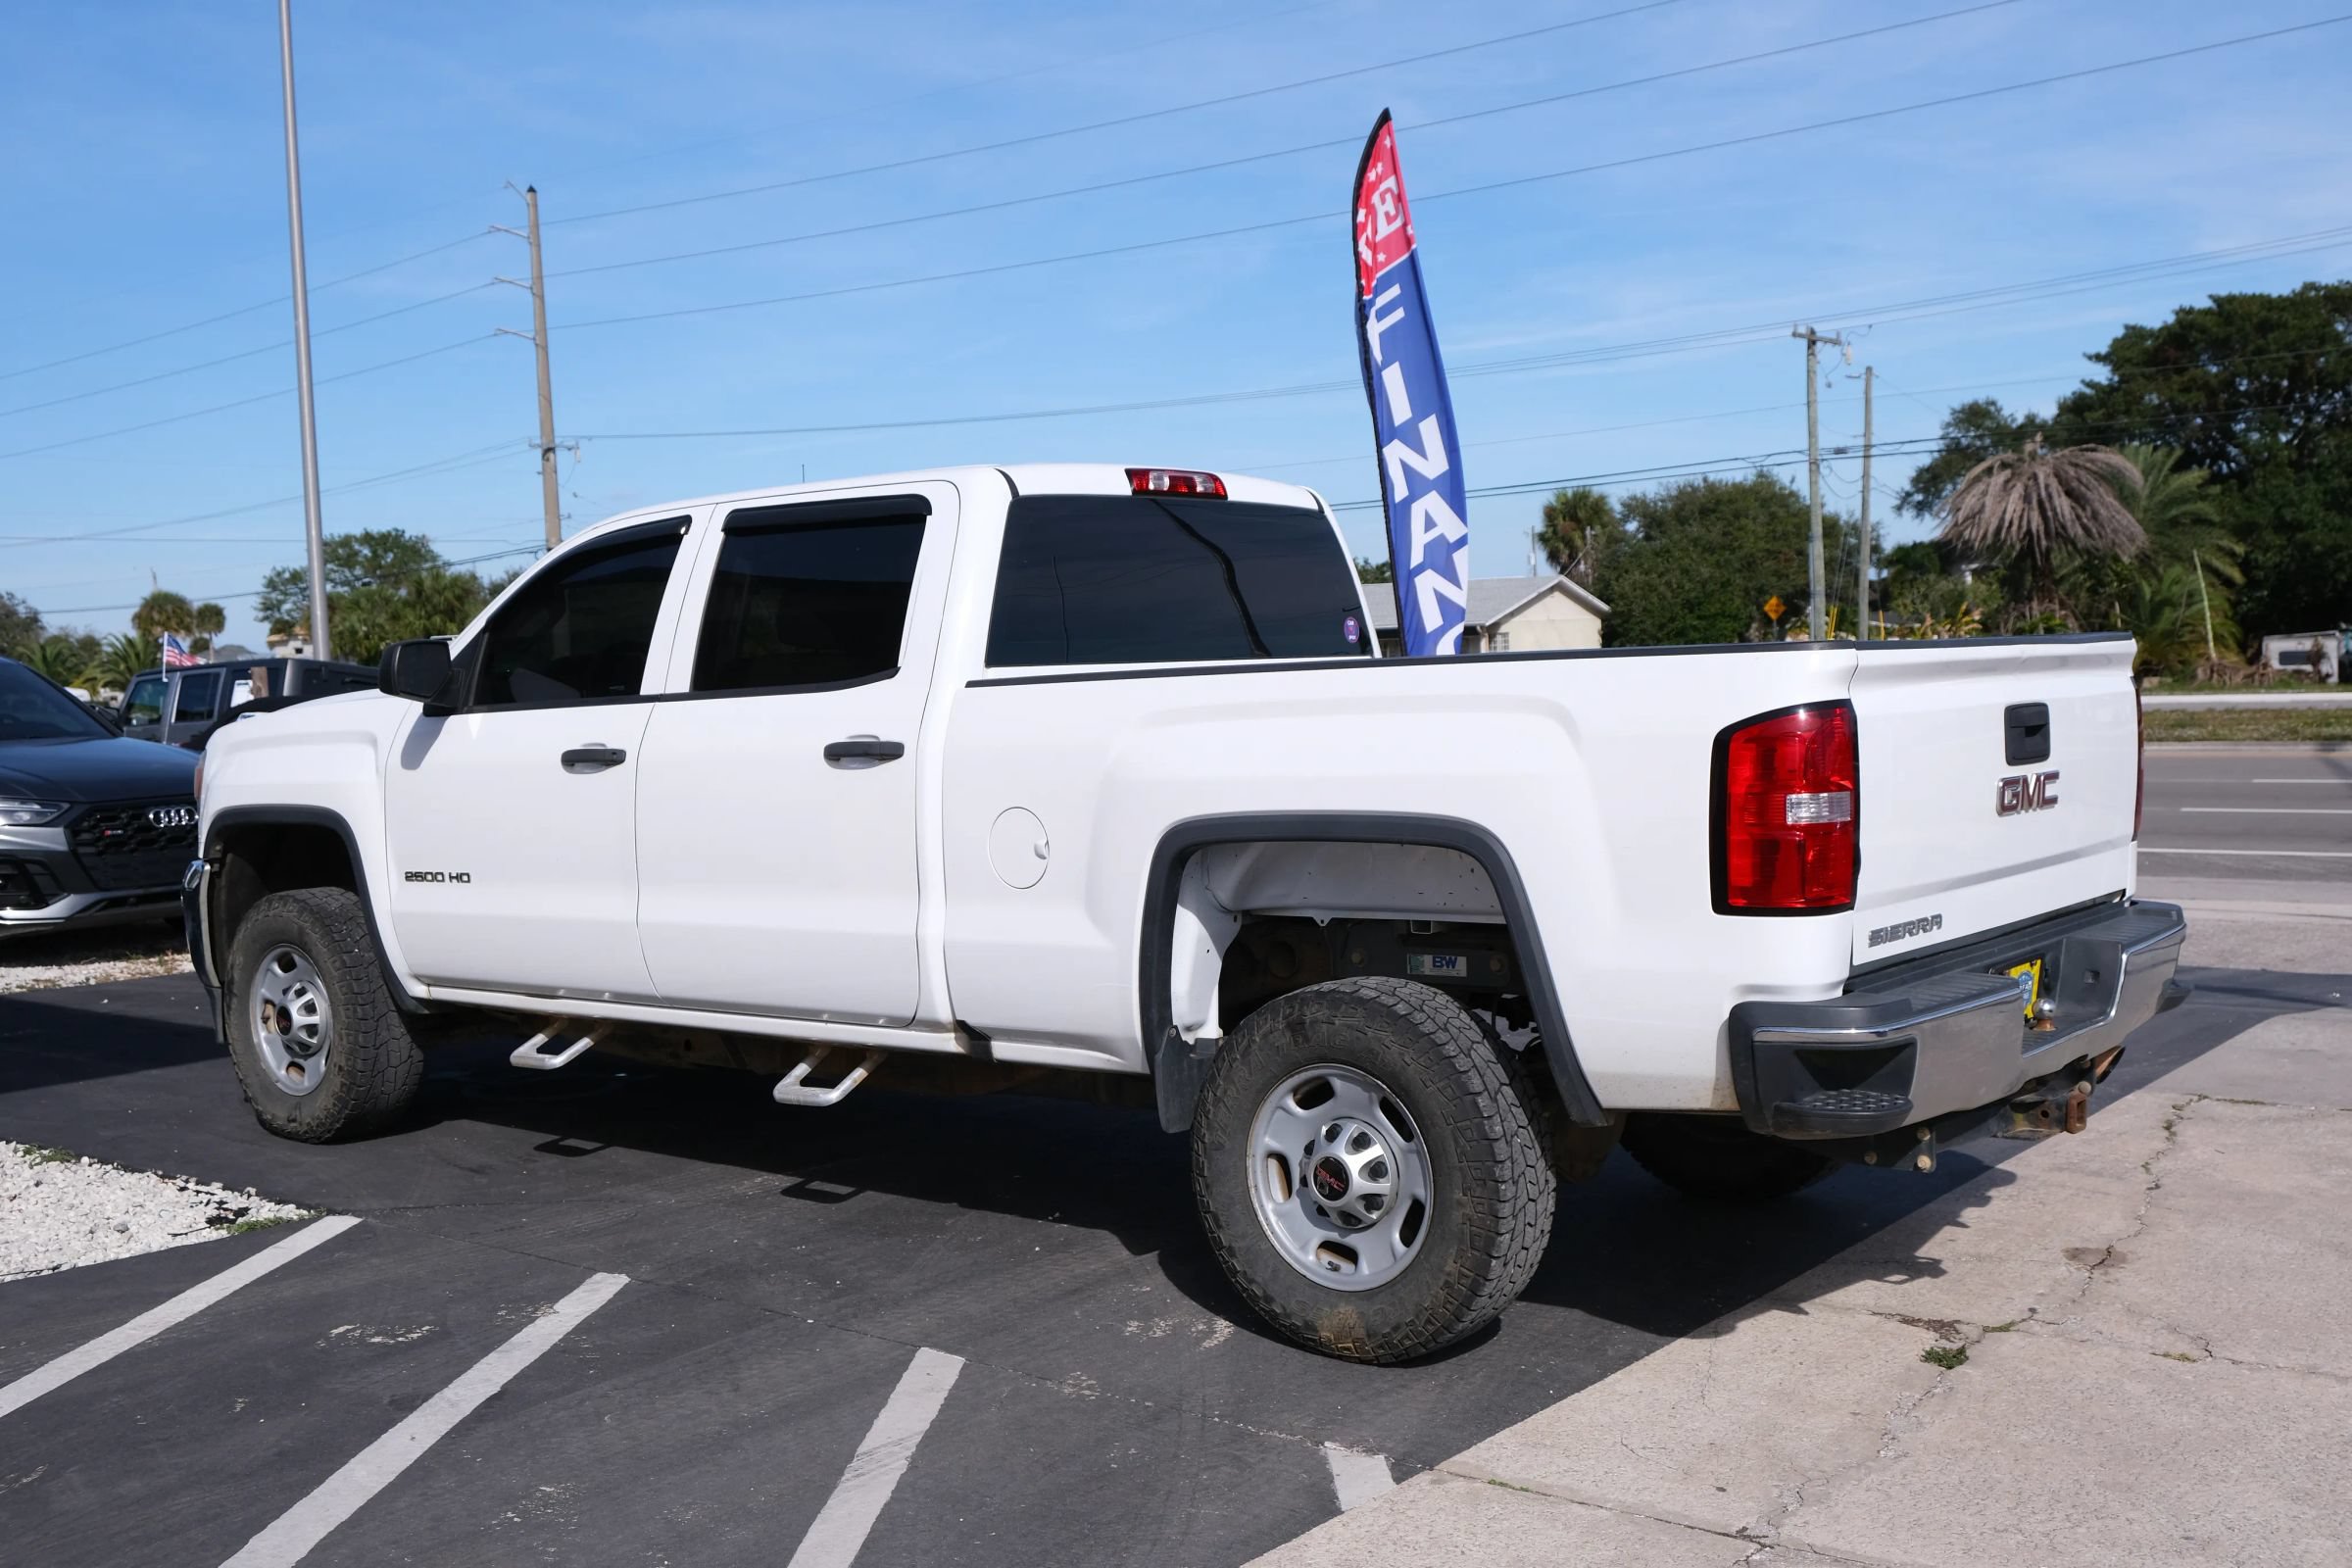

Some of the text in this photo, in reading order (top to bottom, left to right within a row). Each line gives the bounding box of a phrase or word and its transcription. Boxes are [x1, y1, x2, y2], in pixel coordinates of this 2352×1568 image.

[1996, 770, 2060, 817] GMC
[404, 871, 445, 883] 2500
[1868, 913, 1943, 948] SIERRA
